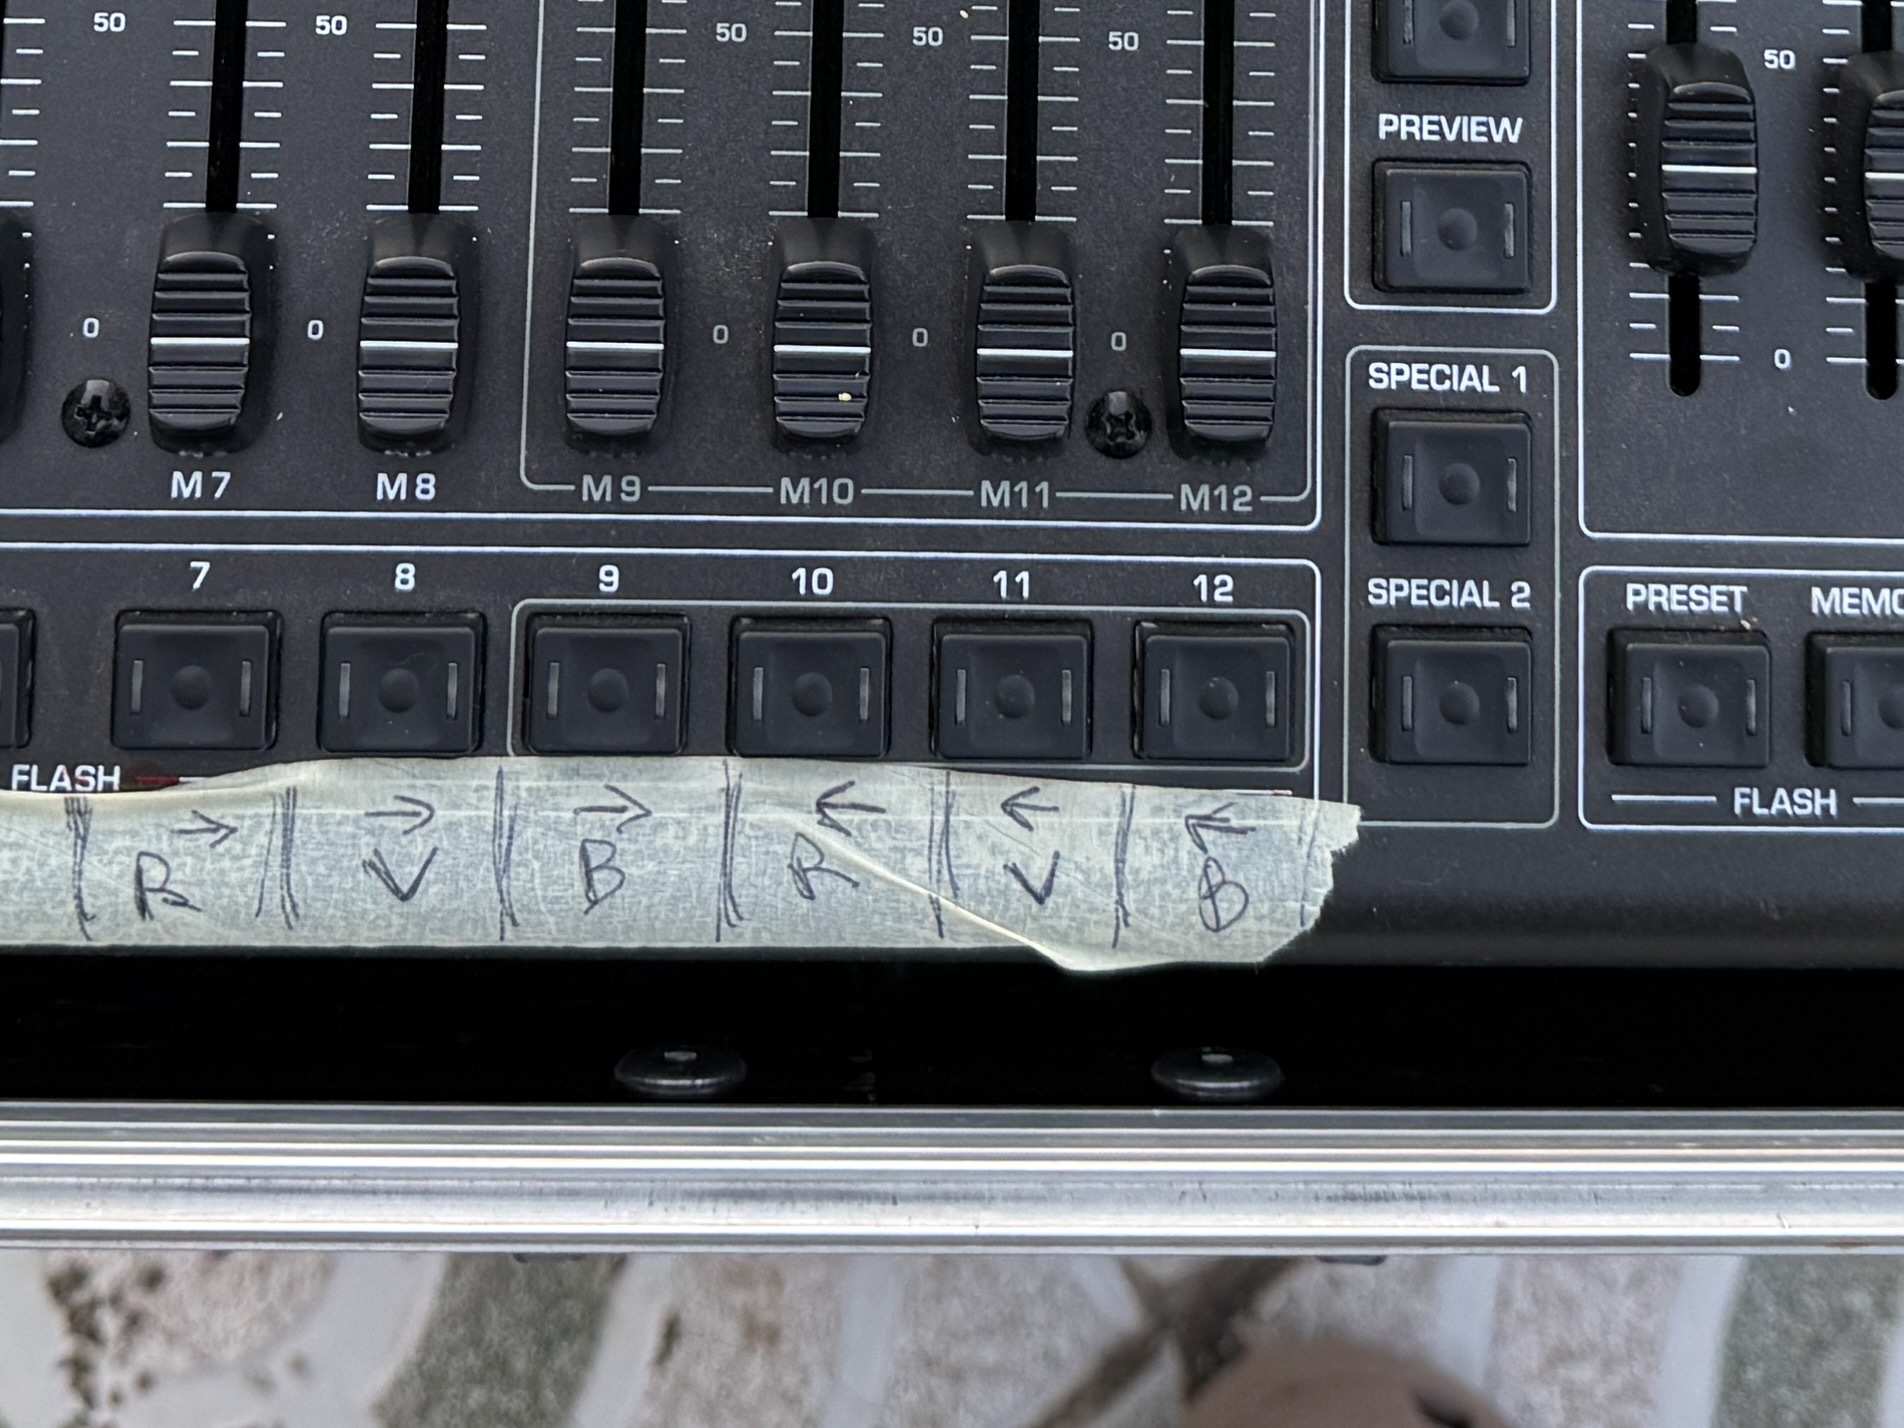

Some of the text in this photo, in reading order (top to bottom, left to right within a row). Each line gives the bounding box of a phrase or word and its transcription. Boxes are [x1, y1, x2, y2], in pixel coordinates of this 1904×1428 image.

[1764, 49, 1796, 70] 50
[1379, 113, 1523, 143] PREVIEW
[1774, 349, 1791, 369] 0
[1369, 362, 1527, 393] SPECIAL 1
[1368, 578, 1531, 608] SPECIAL 2
[1626, 583, 1748, 612] PRESET
[5, 765, 120, 796] FLASH
[1734, 787, 1837, 816] FLASH
[581, 840, 629, 915] B
